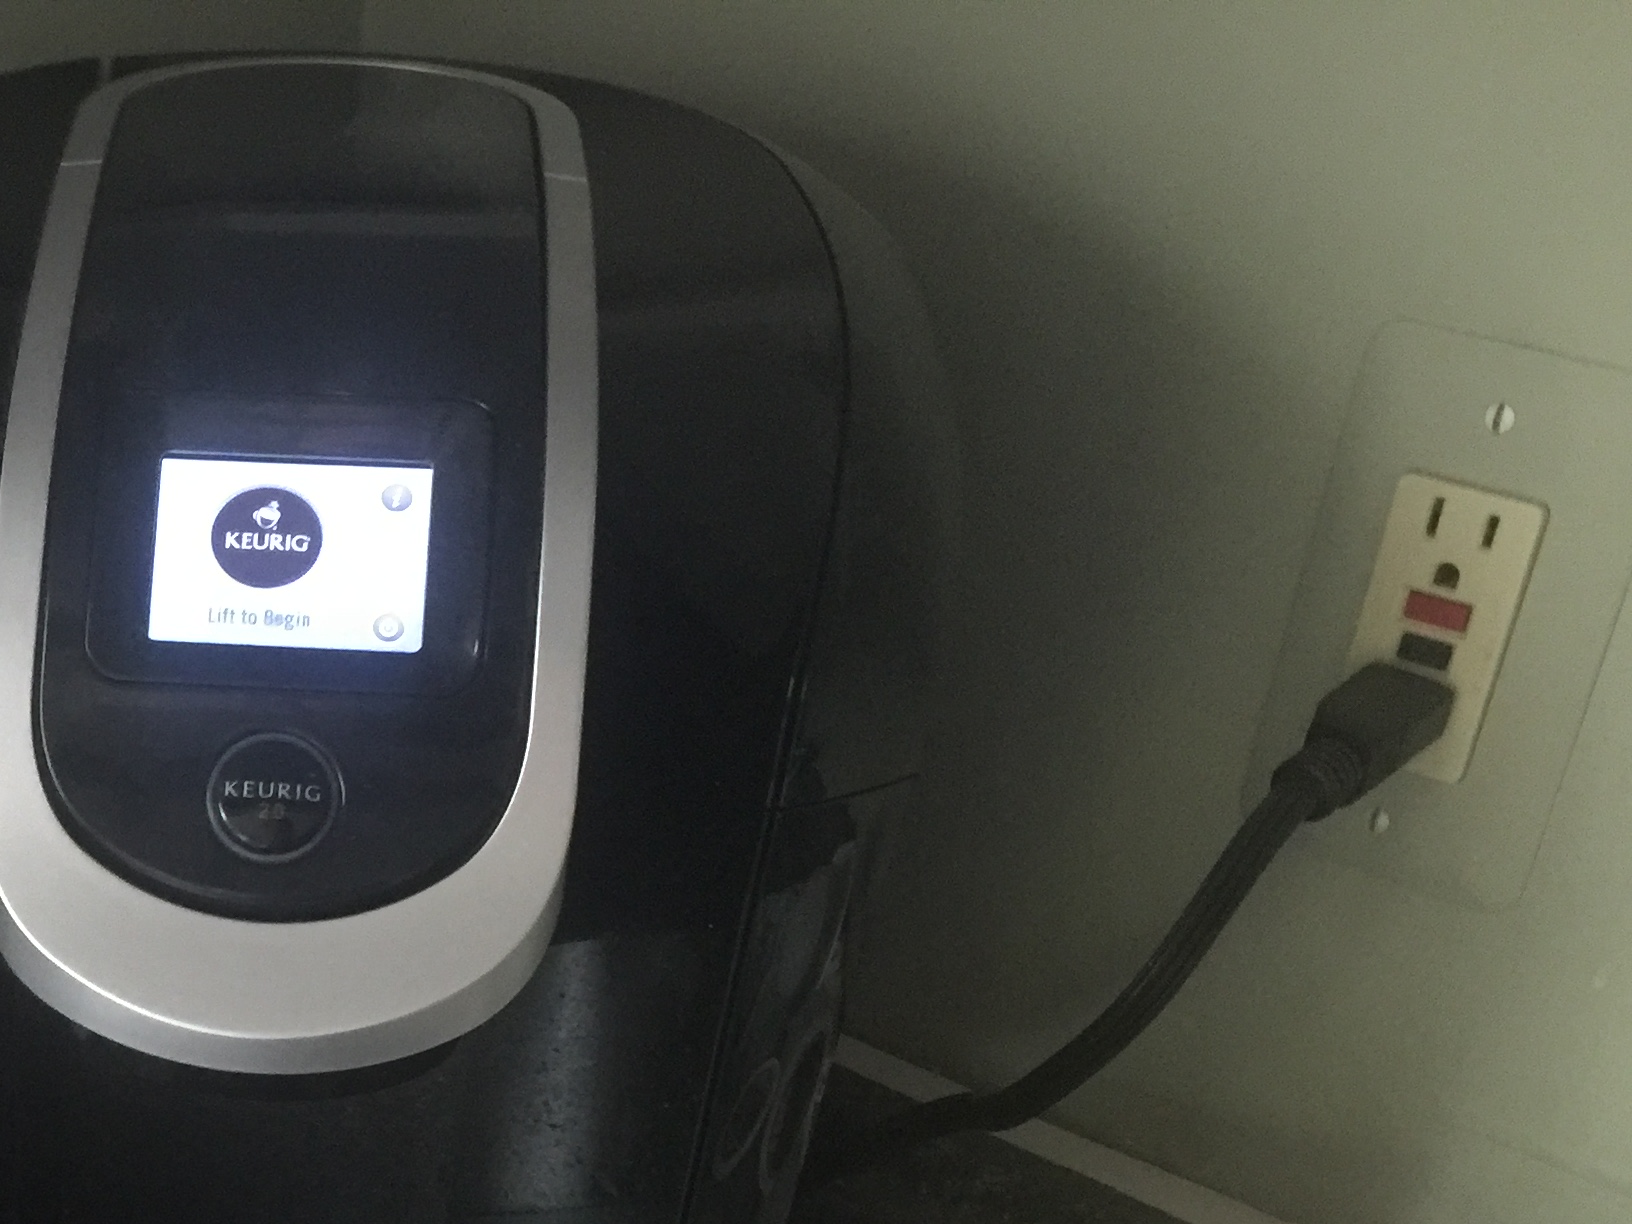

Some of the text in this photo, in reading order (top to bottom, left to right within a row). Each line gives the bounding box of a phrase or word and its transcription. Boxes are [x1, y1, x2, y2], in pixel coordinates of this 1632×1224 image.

[225, 531, 310, 552] KEURIG
[208, 608, 310, 630] Lift to Begin
[225, 781, 321, 801] KEURIG
